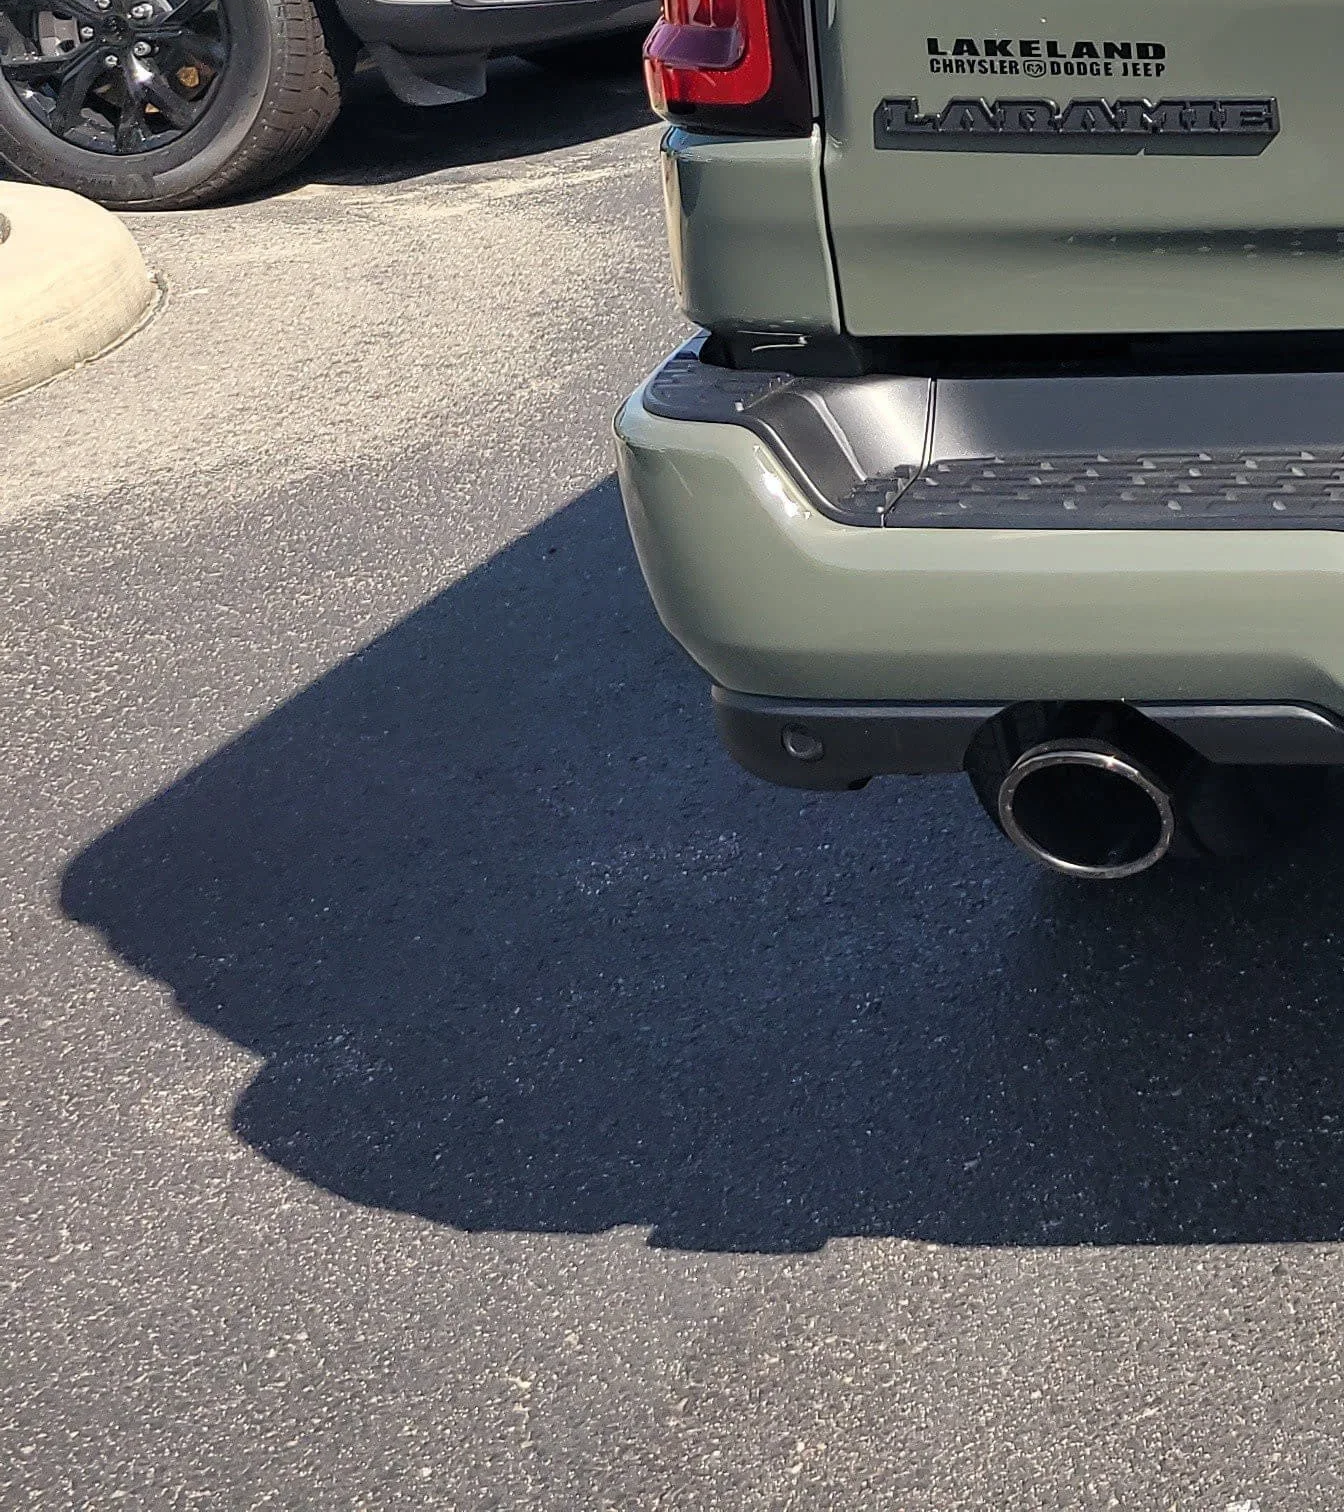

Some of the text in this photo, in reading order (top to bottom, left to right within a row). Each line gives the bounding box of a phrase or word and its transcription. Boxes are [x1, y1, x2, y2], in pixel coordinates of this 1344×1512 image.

[927, 37, 1166, 60] LAKELAND
[929, 59, 1165, 77] CHRYSLER DODGE JEEP
[874, 96, 1281, 156] LARAMIE
